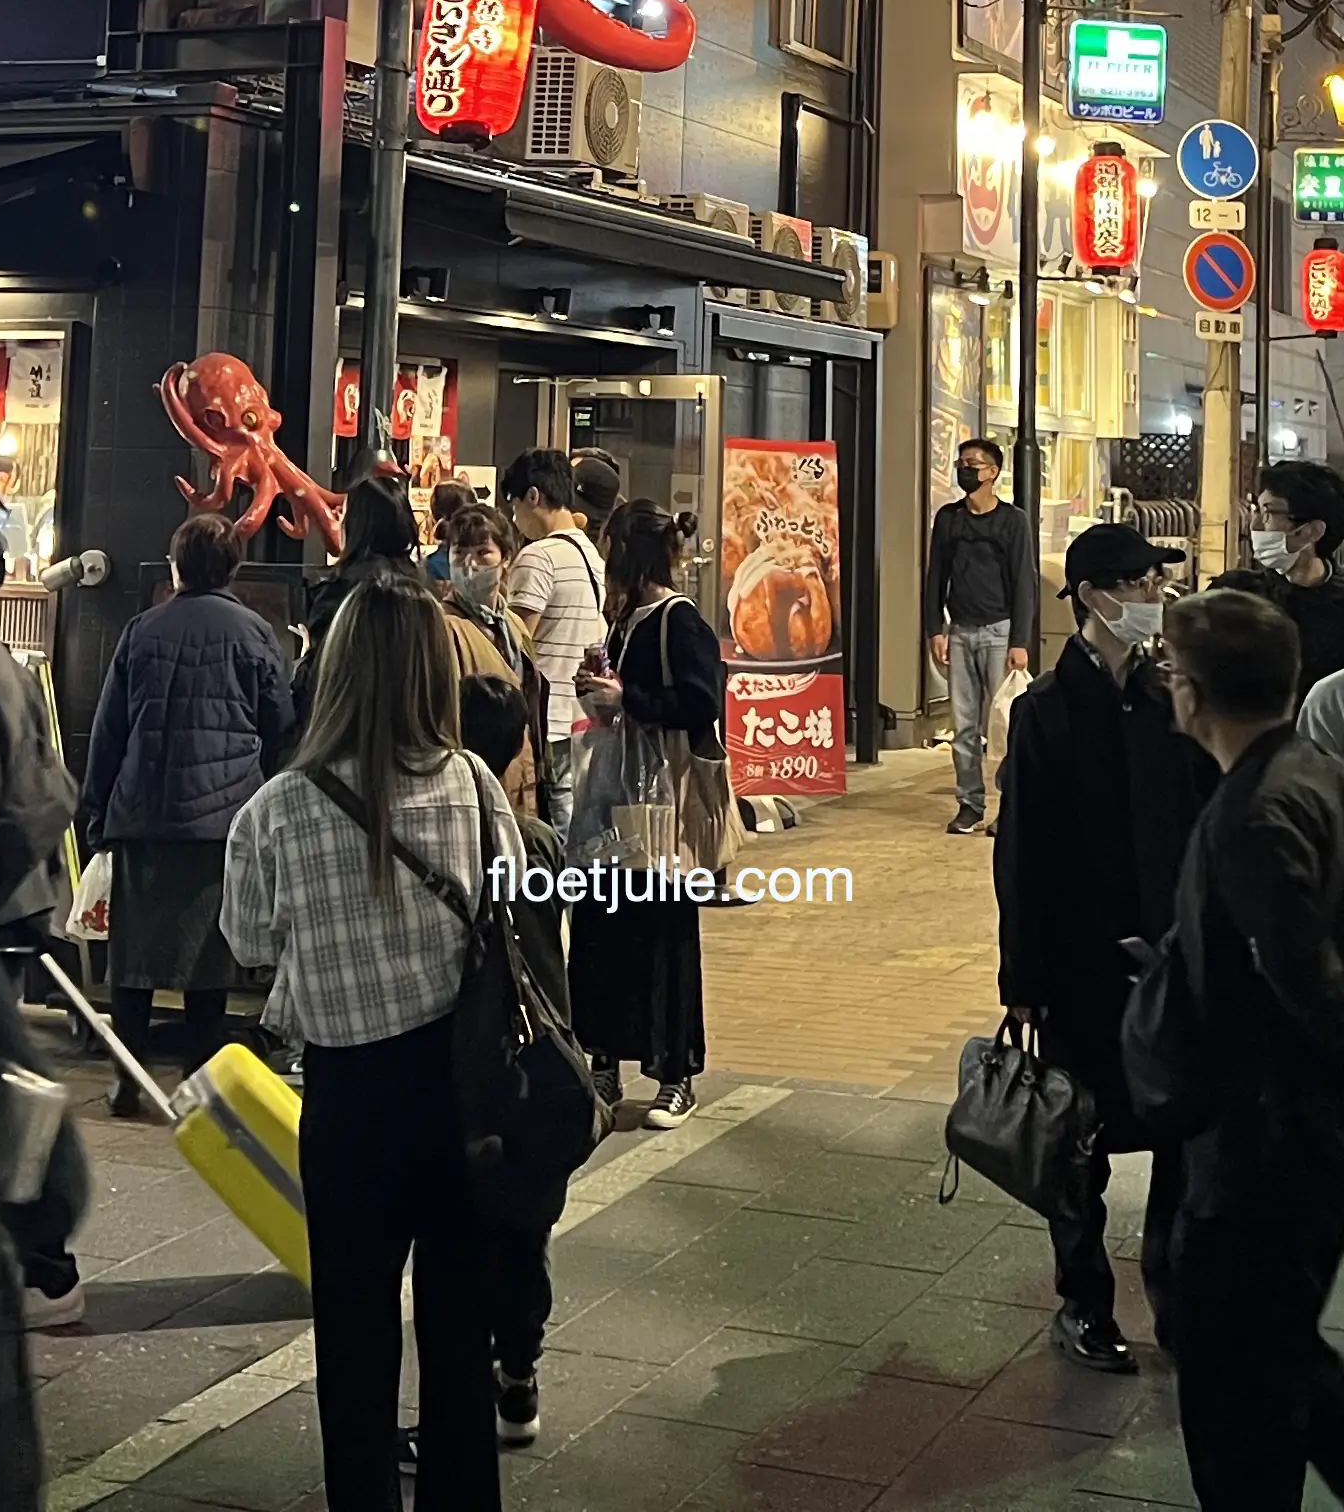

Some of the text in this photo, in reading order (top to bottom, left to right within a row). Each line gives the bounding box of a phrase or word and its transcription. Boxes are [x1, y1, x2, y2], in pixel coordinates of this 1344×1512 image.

[1078, 102, 1157, 120] サッポロビール
[1199, 318, 1241, 335] 自動車
